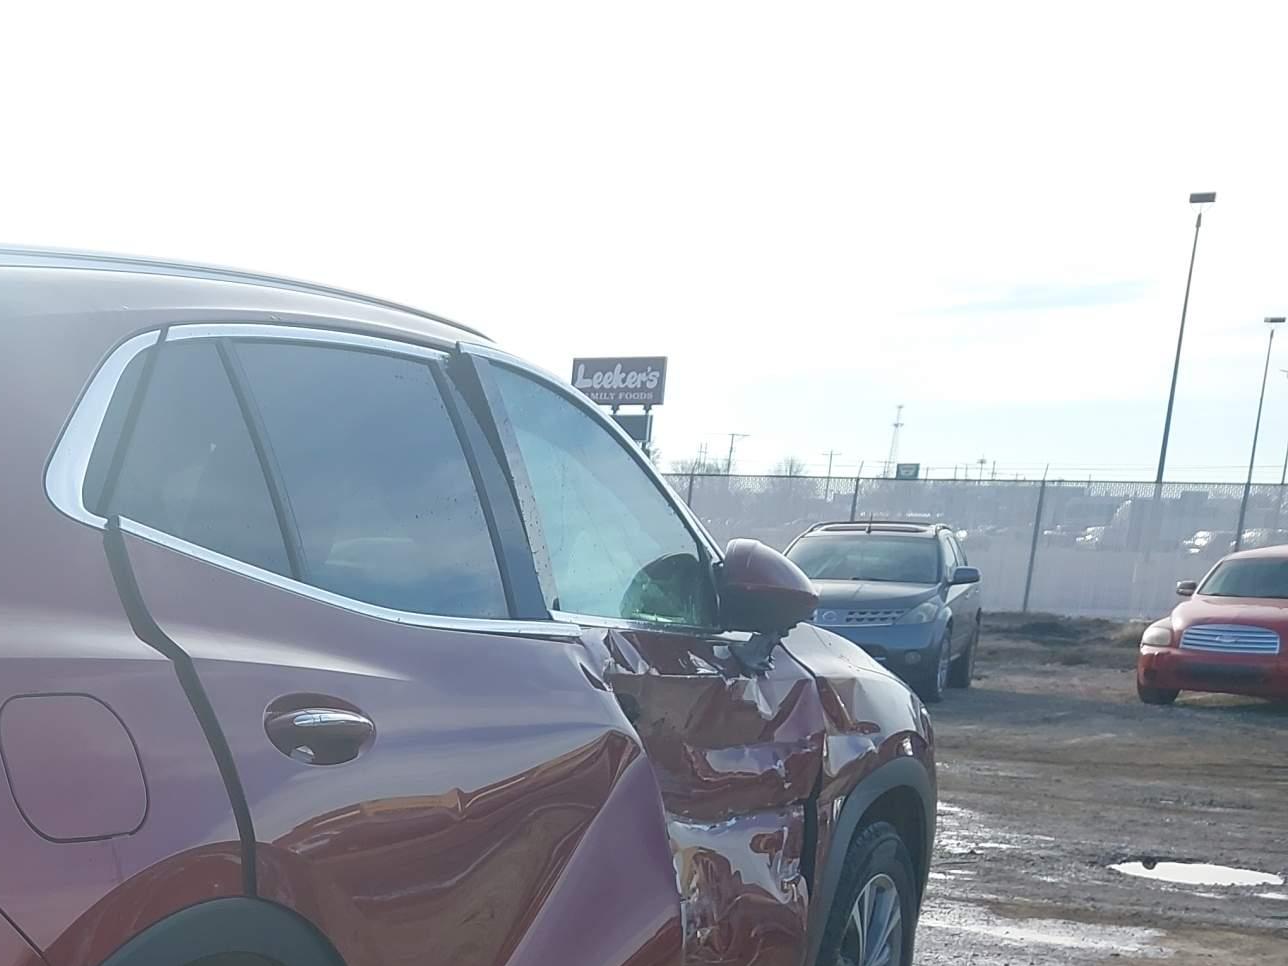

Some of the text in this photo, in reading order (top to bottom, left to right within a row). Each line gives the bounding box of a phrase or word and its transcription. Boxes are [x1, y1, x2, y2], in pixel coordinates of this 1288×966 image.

[574, 363, 660, 389] Leeker's
[586, 392, 653, 401] MILY FOODS
